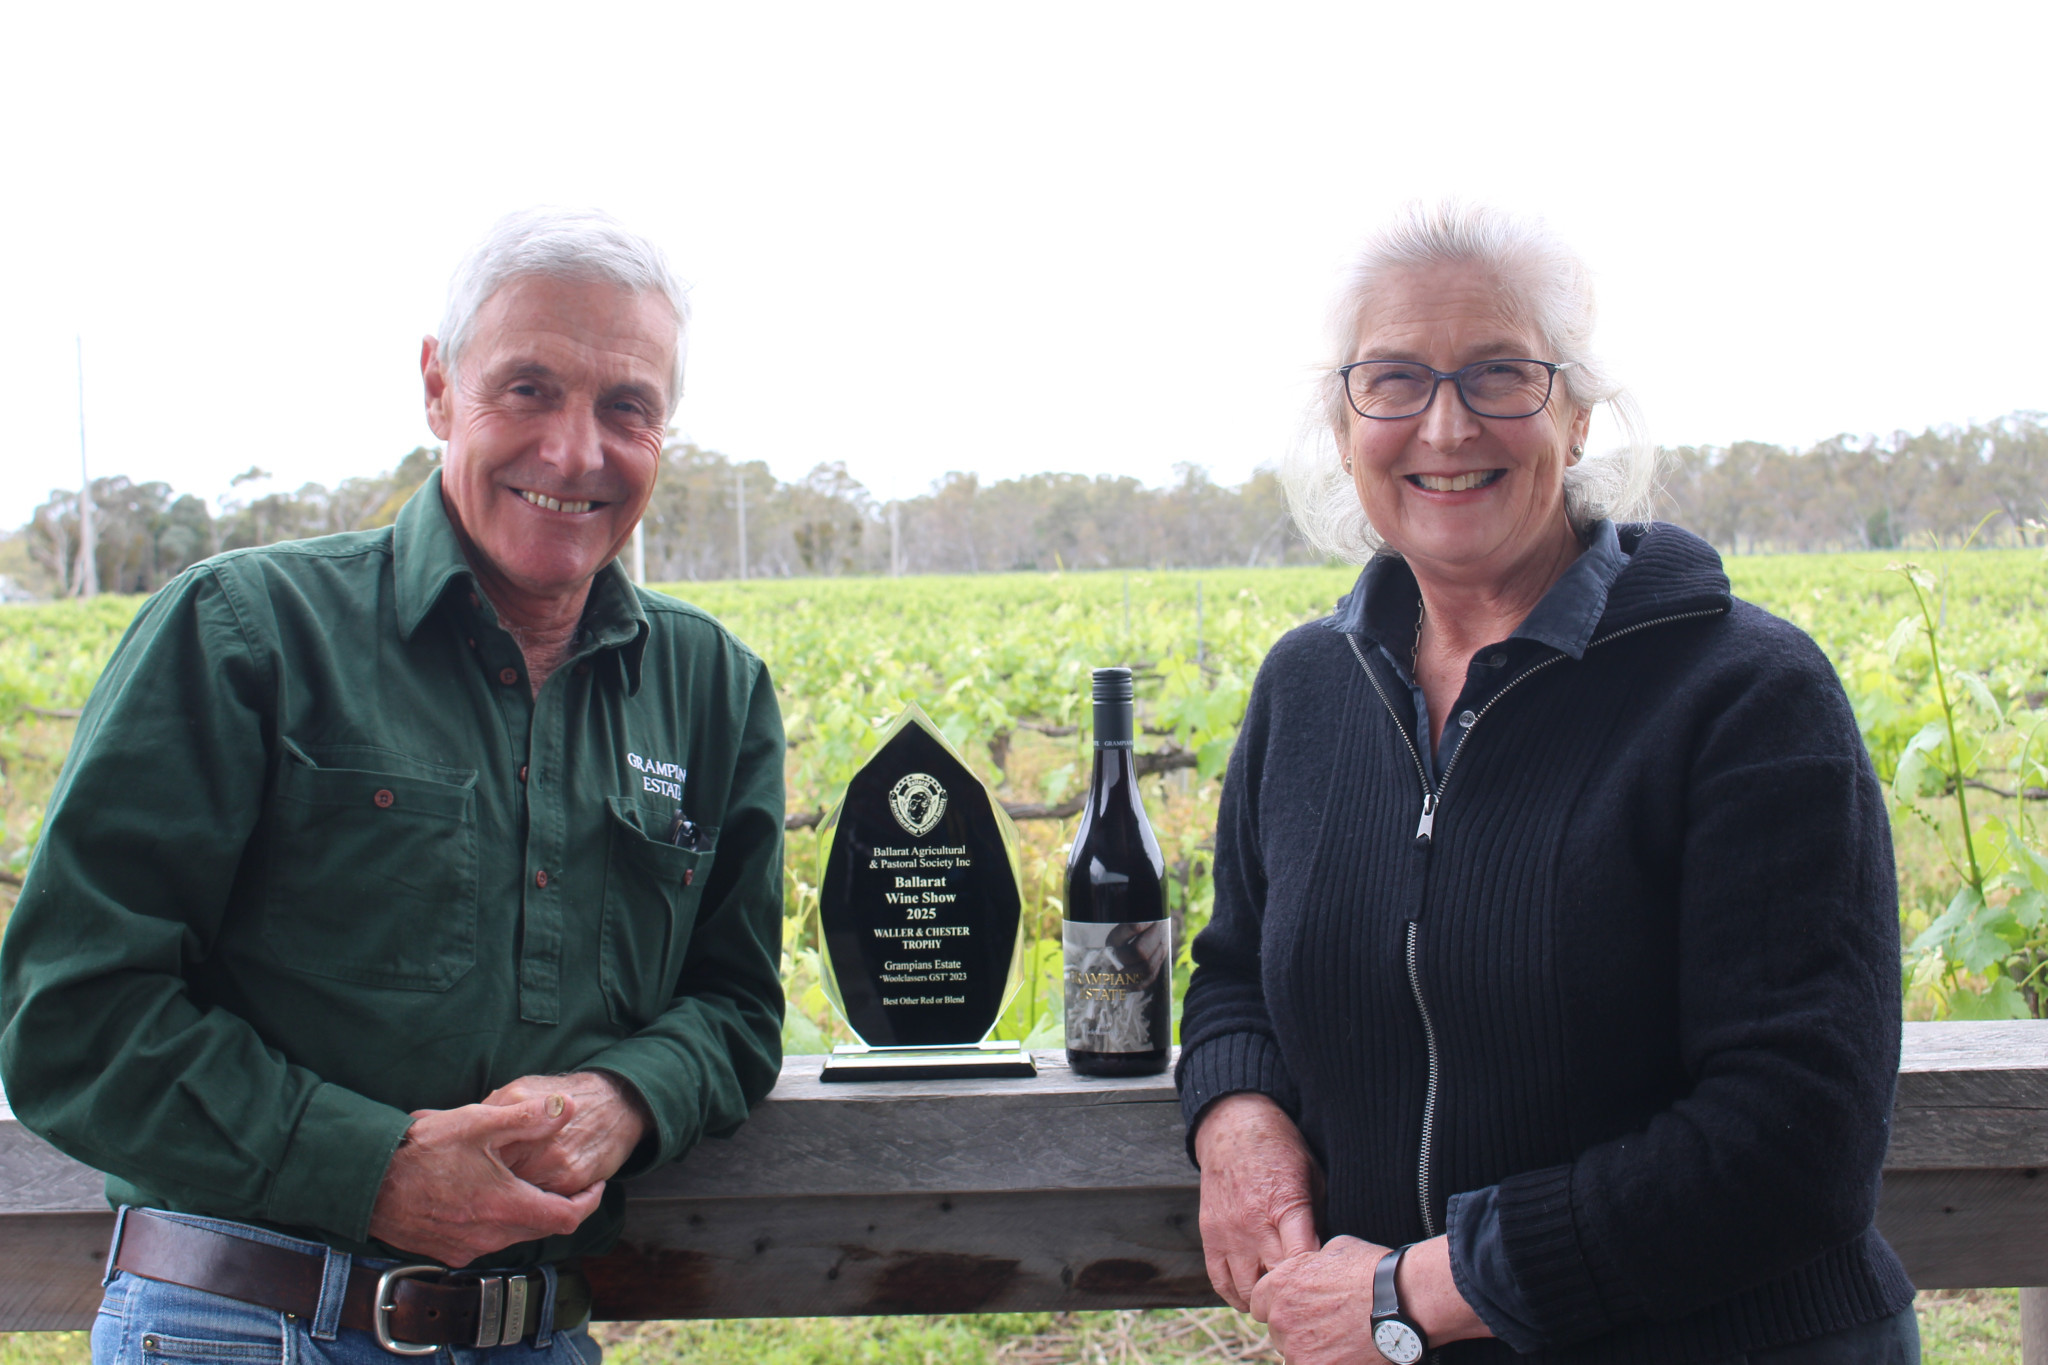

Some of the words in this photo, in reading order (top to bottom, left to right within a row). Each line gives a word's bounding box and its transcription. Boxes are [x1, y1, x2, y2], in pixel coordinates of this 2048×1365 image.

[873, 847, 910, 857] Ballarat
[911, 845, 966, 858] Agricultural
[869, 859, 879, 869] &
[880, 858, 918, 869] Pastoral
[919, 857, 954, 869] Society
[956, 857, 971, 867] Inc
[894, 876, 947, 888] Ballarat
[885, 893, 919, 904] Wine
[921, 892, 957, 904] Show
[906, 908, 937, 920] 2025
[873, 928, 914, 938] WALLER
[915, 927, 924, 937] &
[925, 926, 971, 937] CHESTER
[902, 940, 942, 950] TROPHY
[884, 960, 932, 972] Grampians
[934, 959, 962, 970] Estate
[949, 972, 968, 981] 2023
[882, 997, 898, 1006] Best
[899, 997, 920, 1005] Other
[920, 996, 935, 1005] Red
[944, 995, 966, 1004] Blend
